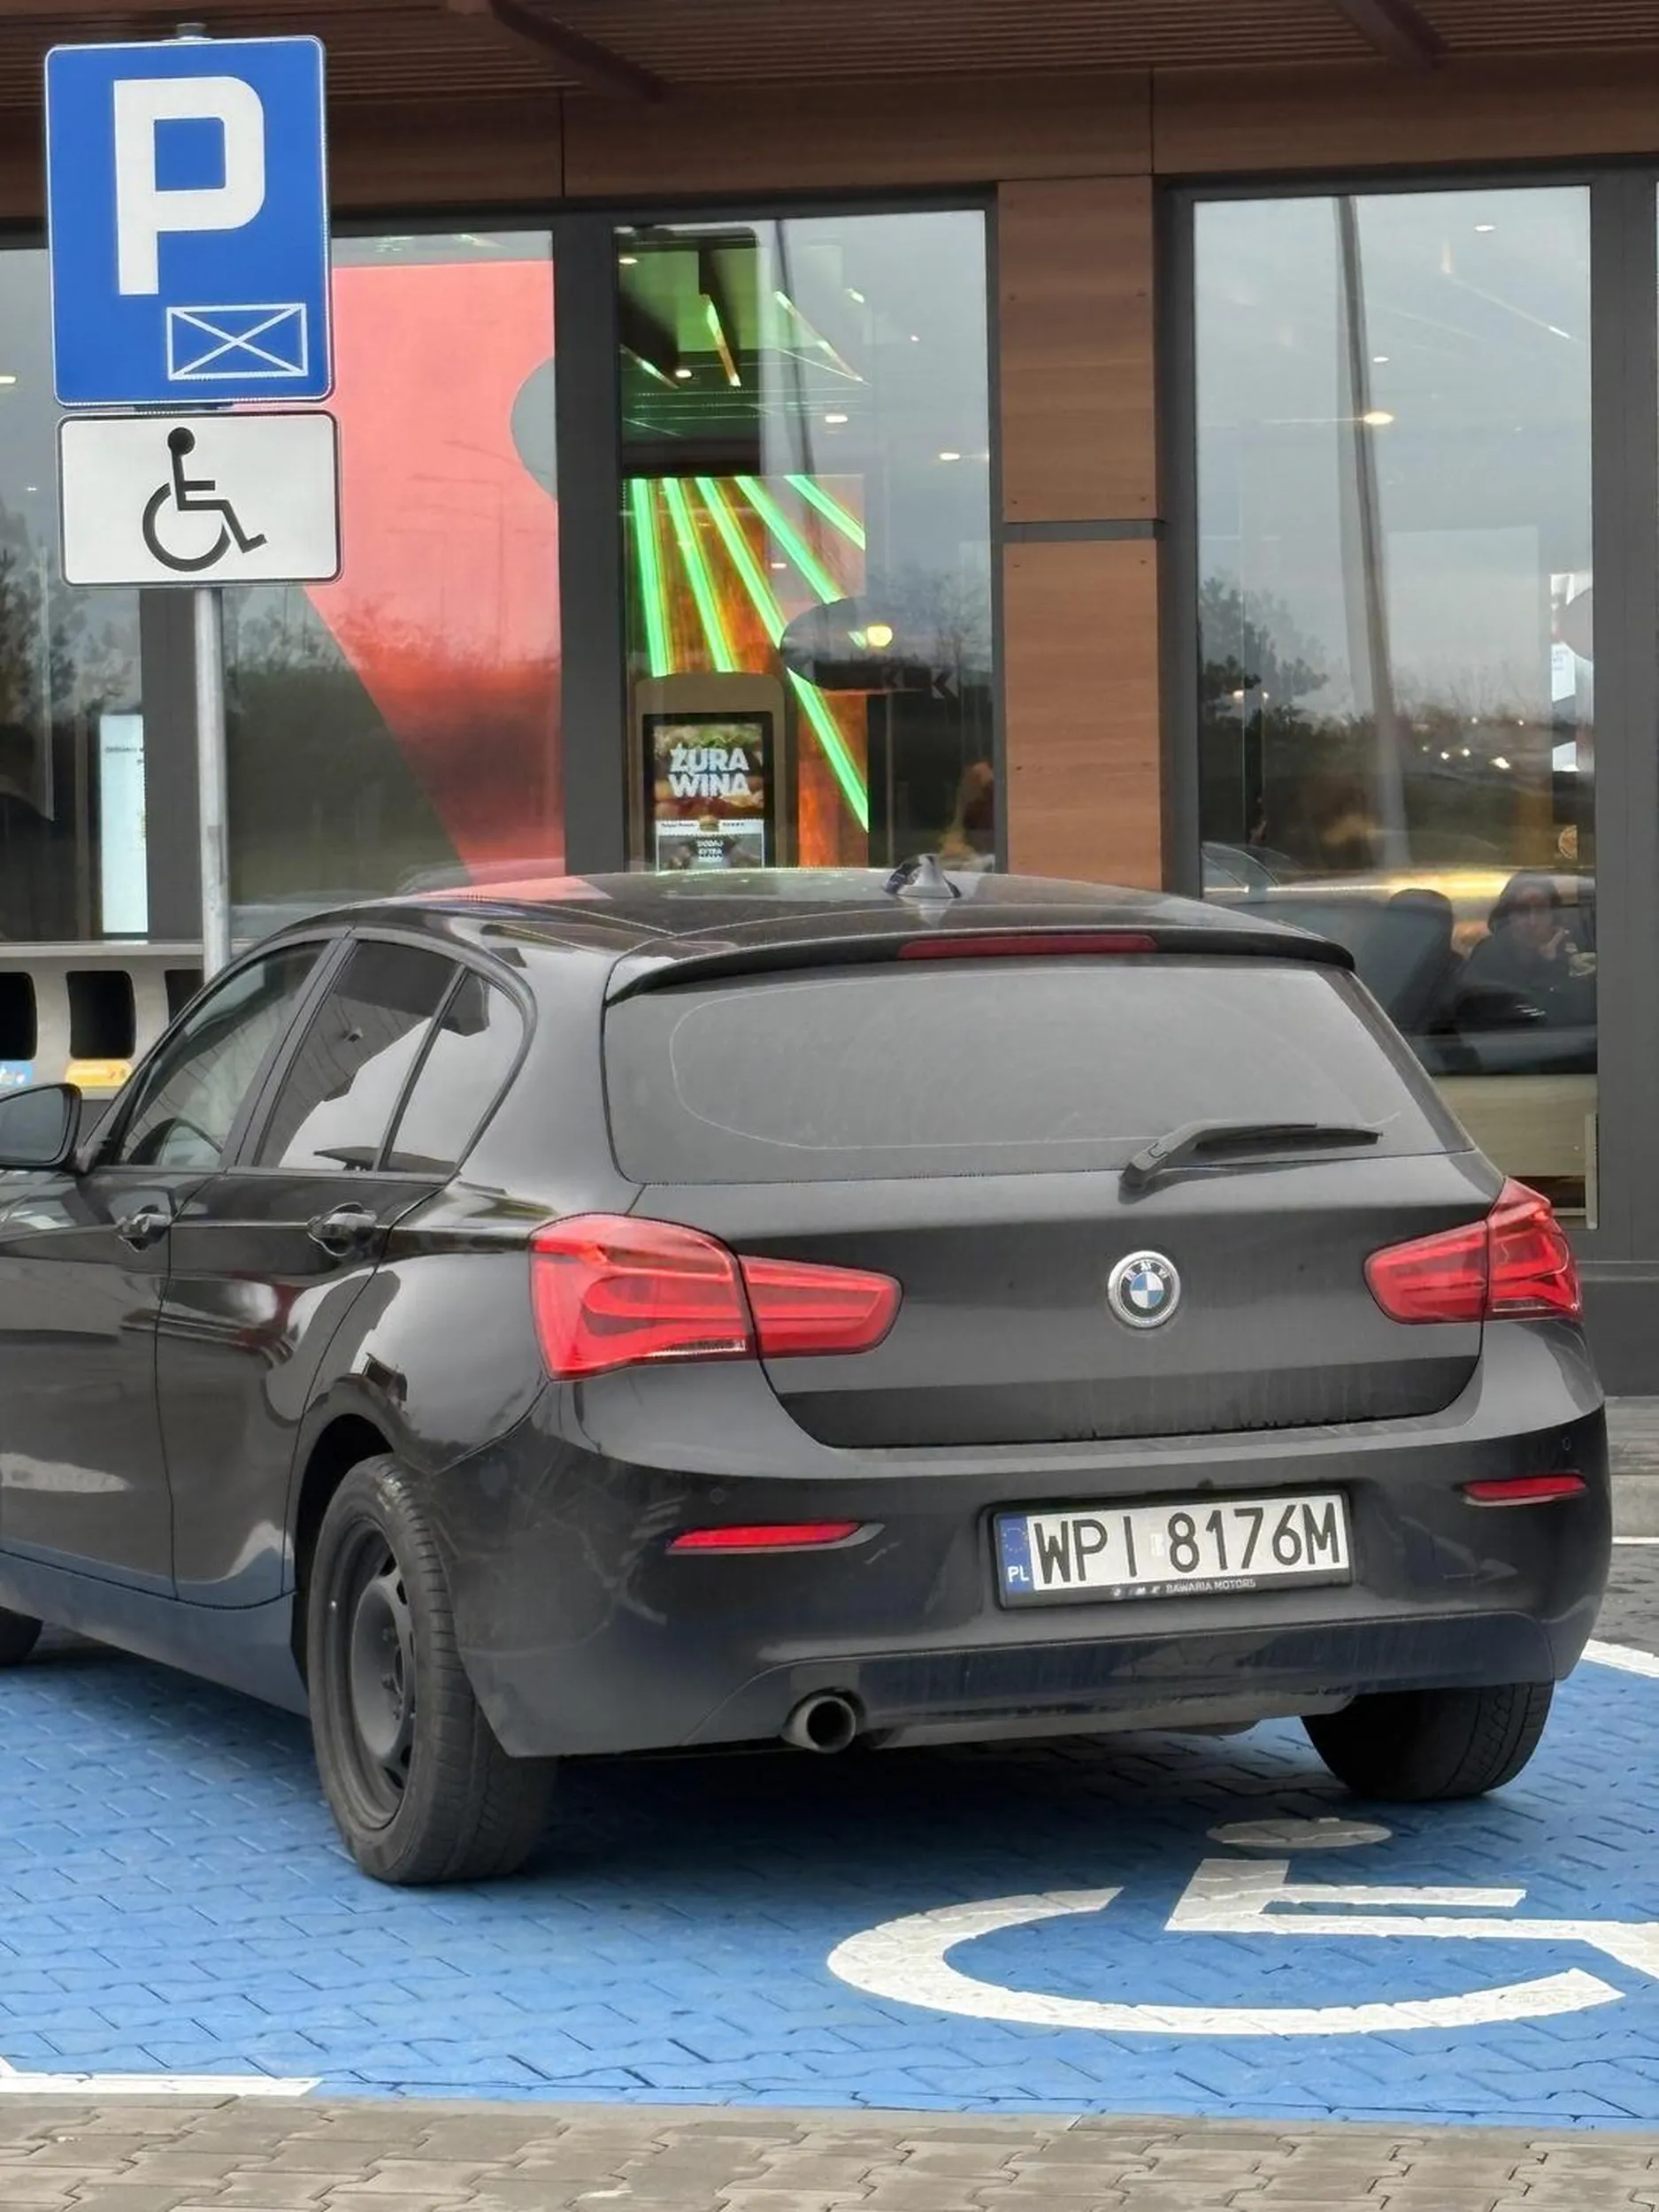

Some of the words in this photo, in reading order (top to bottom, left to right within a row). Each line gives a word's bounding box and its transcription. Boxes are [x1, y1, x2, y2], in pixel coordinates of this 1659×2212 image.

[114, 76, 265, 296] P
[670, 743, 749, 772] ŻURA
[669, 772, 752, 798] WINA
[1167, 1502, 1340, 1573] 8176M
[1007, 1565, 1029, 1583] PL
[1213, 1578, 1256, 1591] MOTORS
